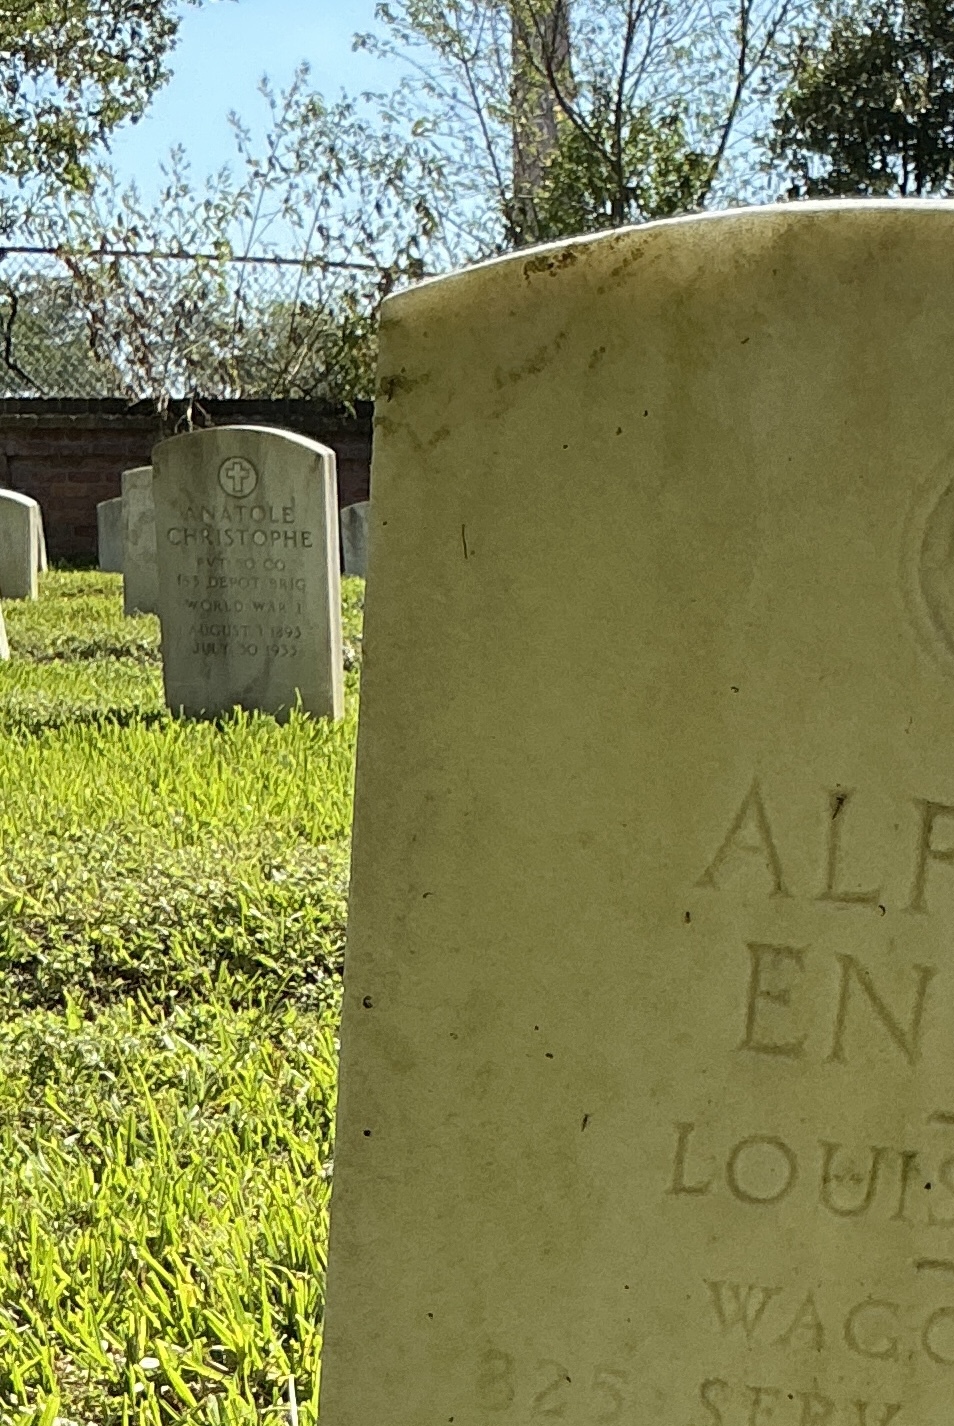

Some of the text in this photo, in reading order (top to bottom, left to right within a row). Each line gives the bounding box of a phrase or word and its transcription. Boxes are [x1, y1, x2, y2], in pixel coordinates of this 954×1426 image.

[182, 505, 295, 525] ANATOLE
[166, 526, 314, 549] CHRISTOPHE
[206, 575, 260, 591] DEPOT
[185, 599, 243, 613] WORLD
[252, 600, 287, 614] WAR
[189, 623, 250, 638] AUGUST
